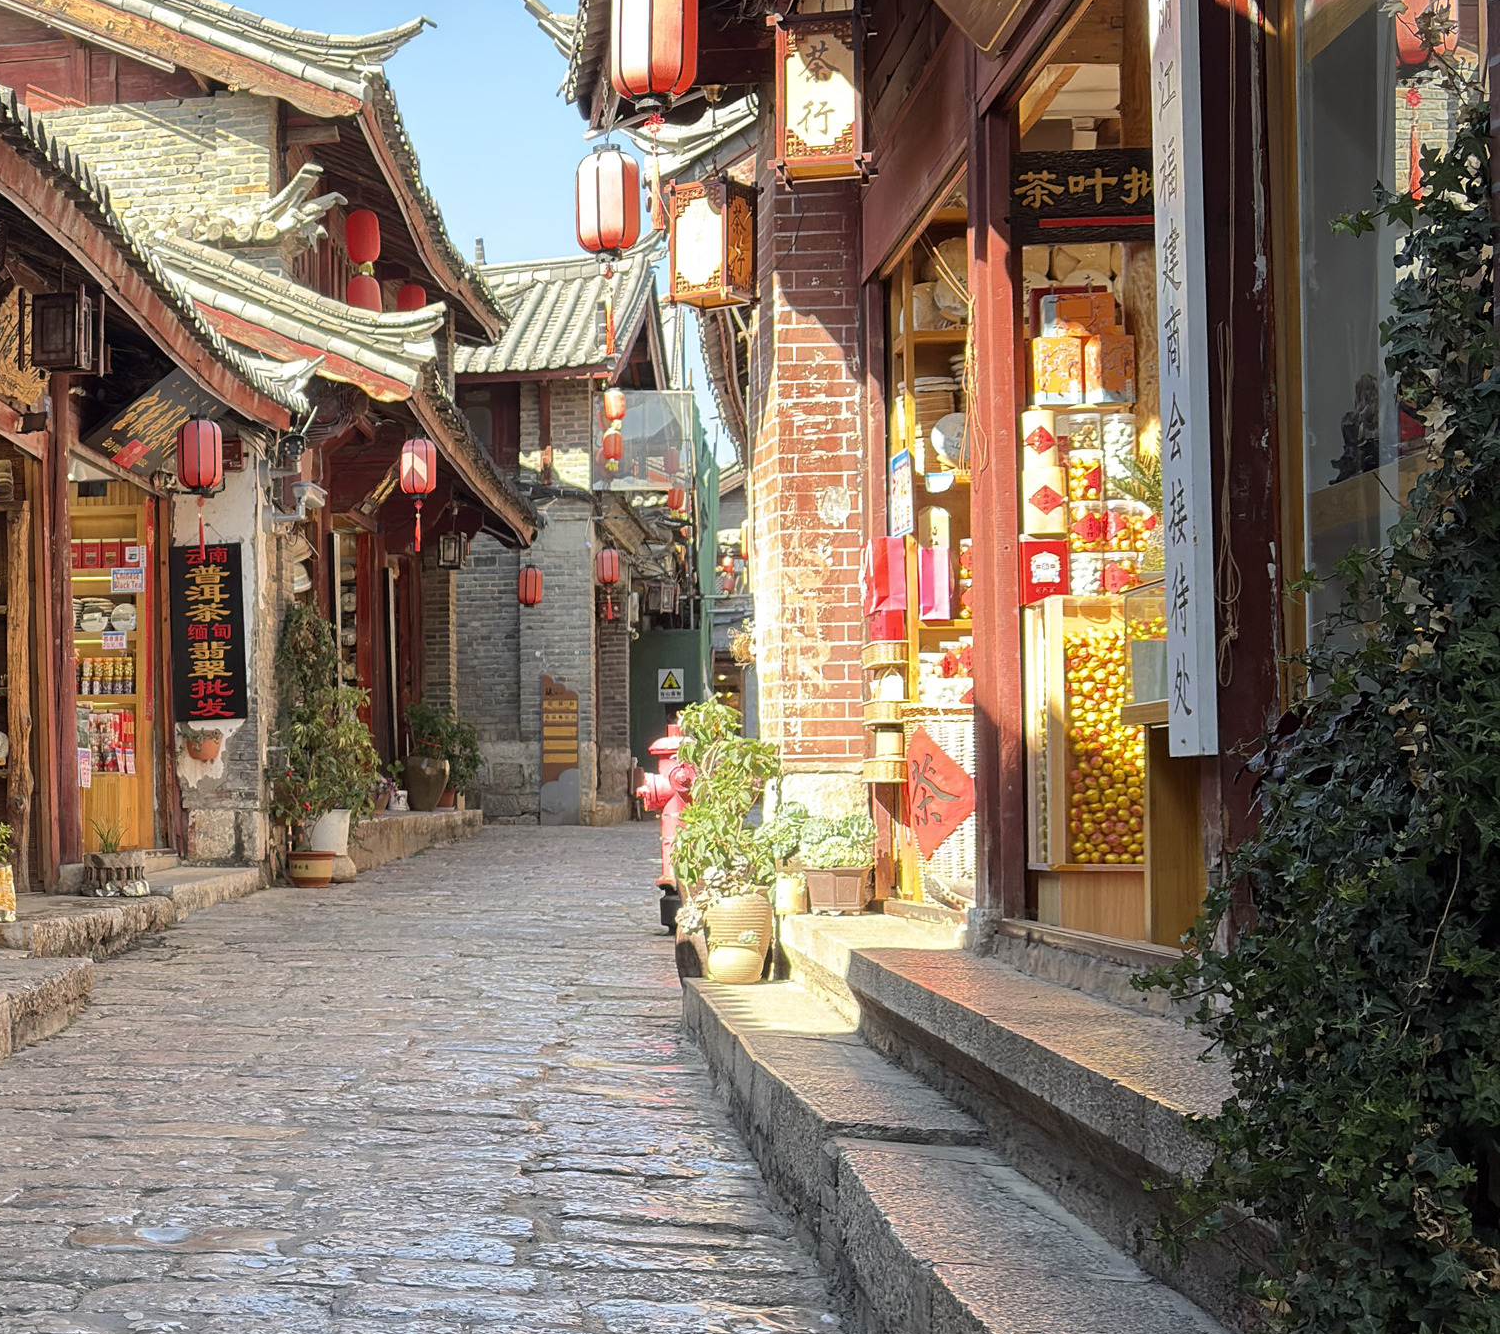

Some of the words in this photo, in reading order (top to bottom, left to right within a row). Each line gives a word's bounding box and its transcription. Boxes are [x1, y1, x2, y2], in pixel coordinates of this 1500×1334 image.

[797, 40, 840, 136] 茶行
[729, 204, 747, 278] 茶行
[185, 547, 228, 565] 云南
[114, 581, 131, 589] Black
[132, 581, 142, 589] Tea
[184, 564, 231, 622] 普洱茶
[187, 623, 232, 640] 缅甸
[187, 641, 233, 679] 翡翠
[189, 679, 236, 717] 批发
[912, 753, 961, 826] 茶
